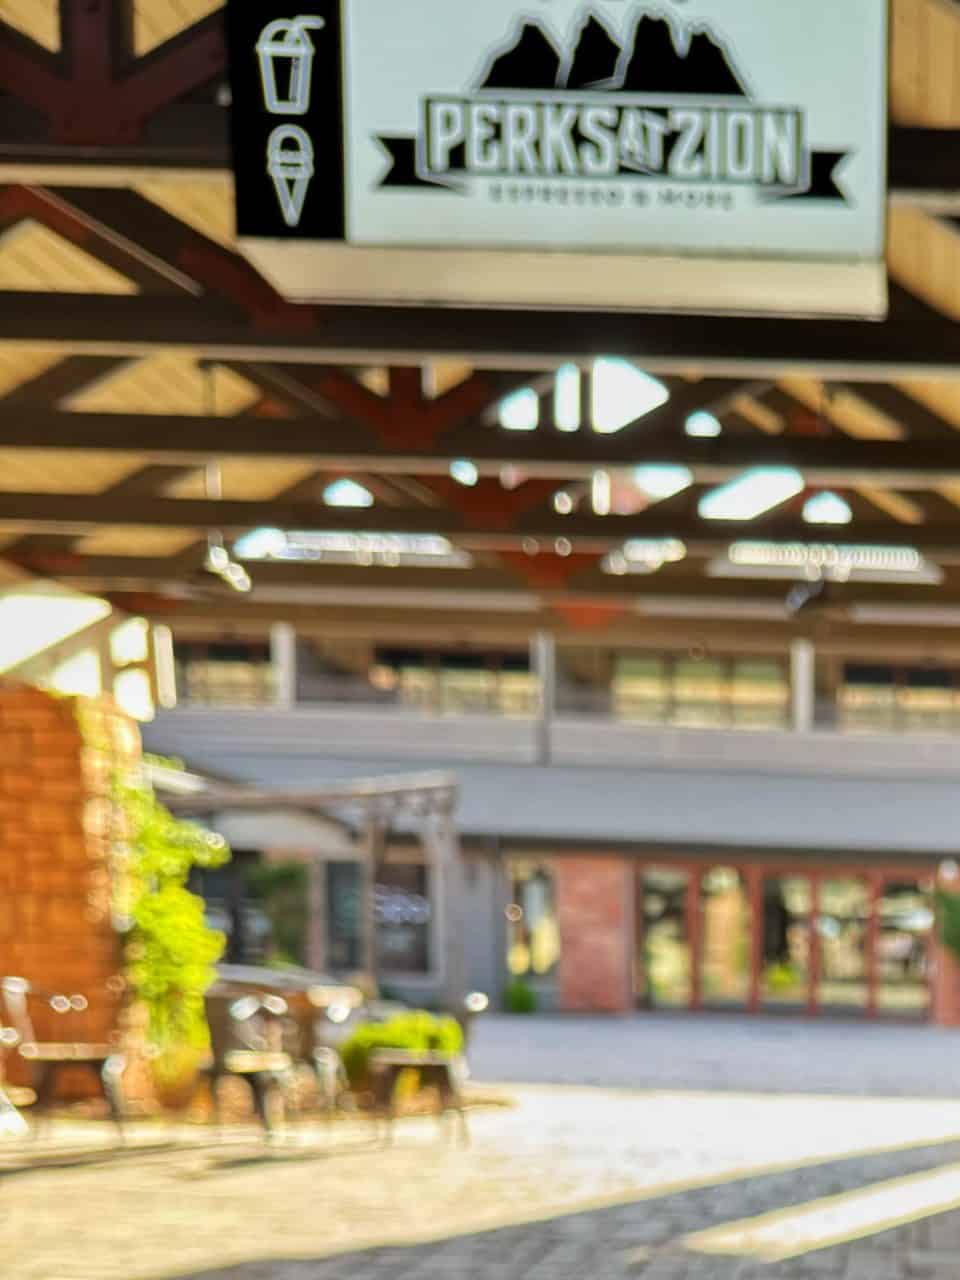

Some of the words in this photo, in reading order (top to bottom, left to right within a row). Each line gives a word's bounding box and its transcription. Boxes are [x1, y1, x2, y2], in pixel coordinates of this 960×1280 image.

[431, 102, 618, 174] PERKS
[621, 105, 672, 170] AT
[670, 109, 798, 184] ZION
